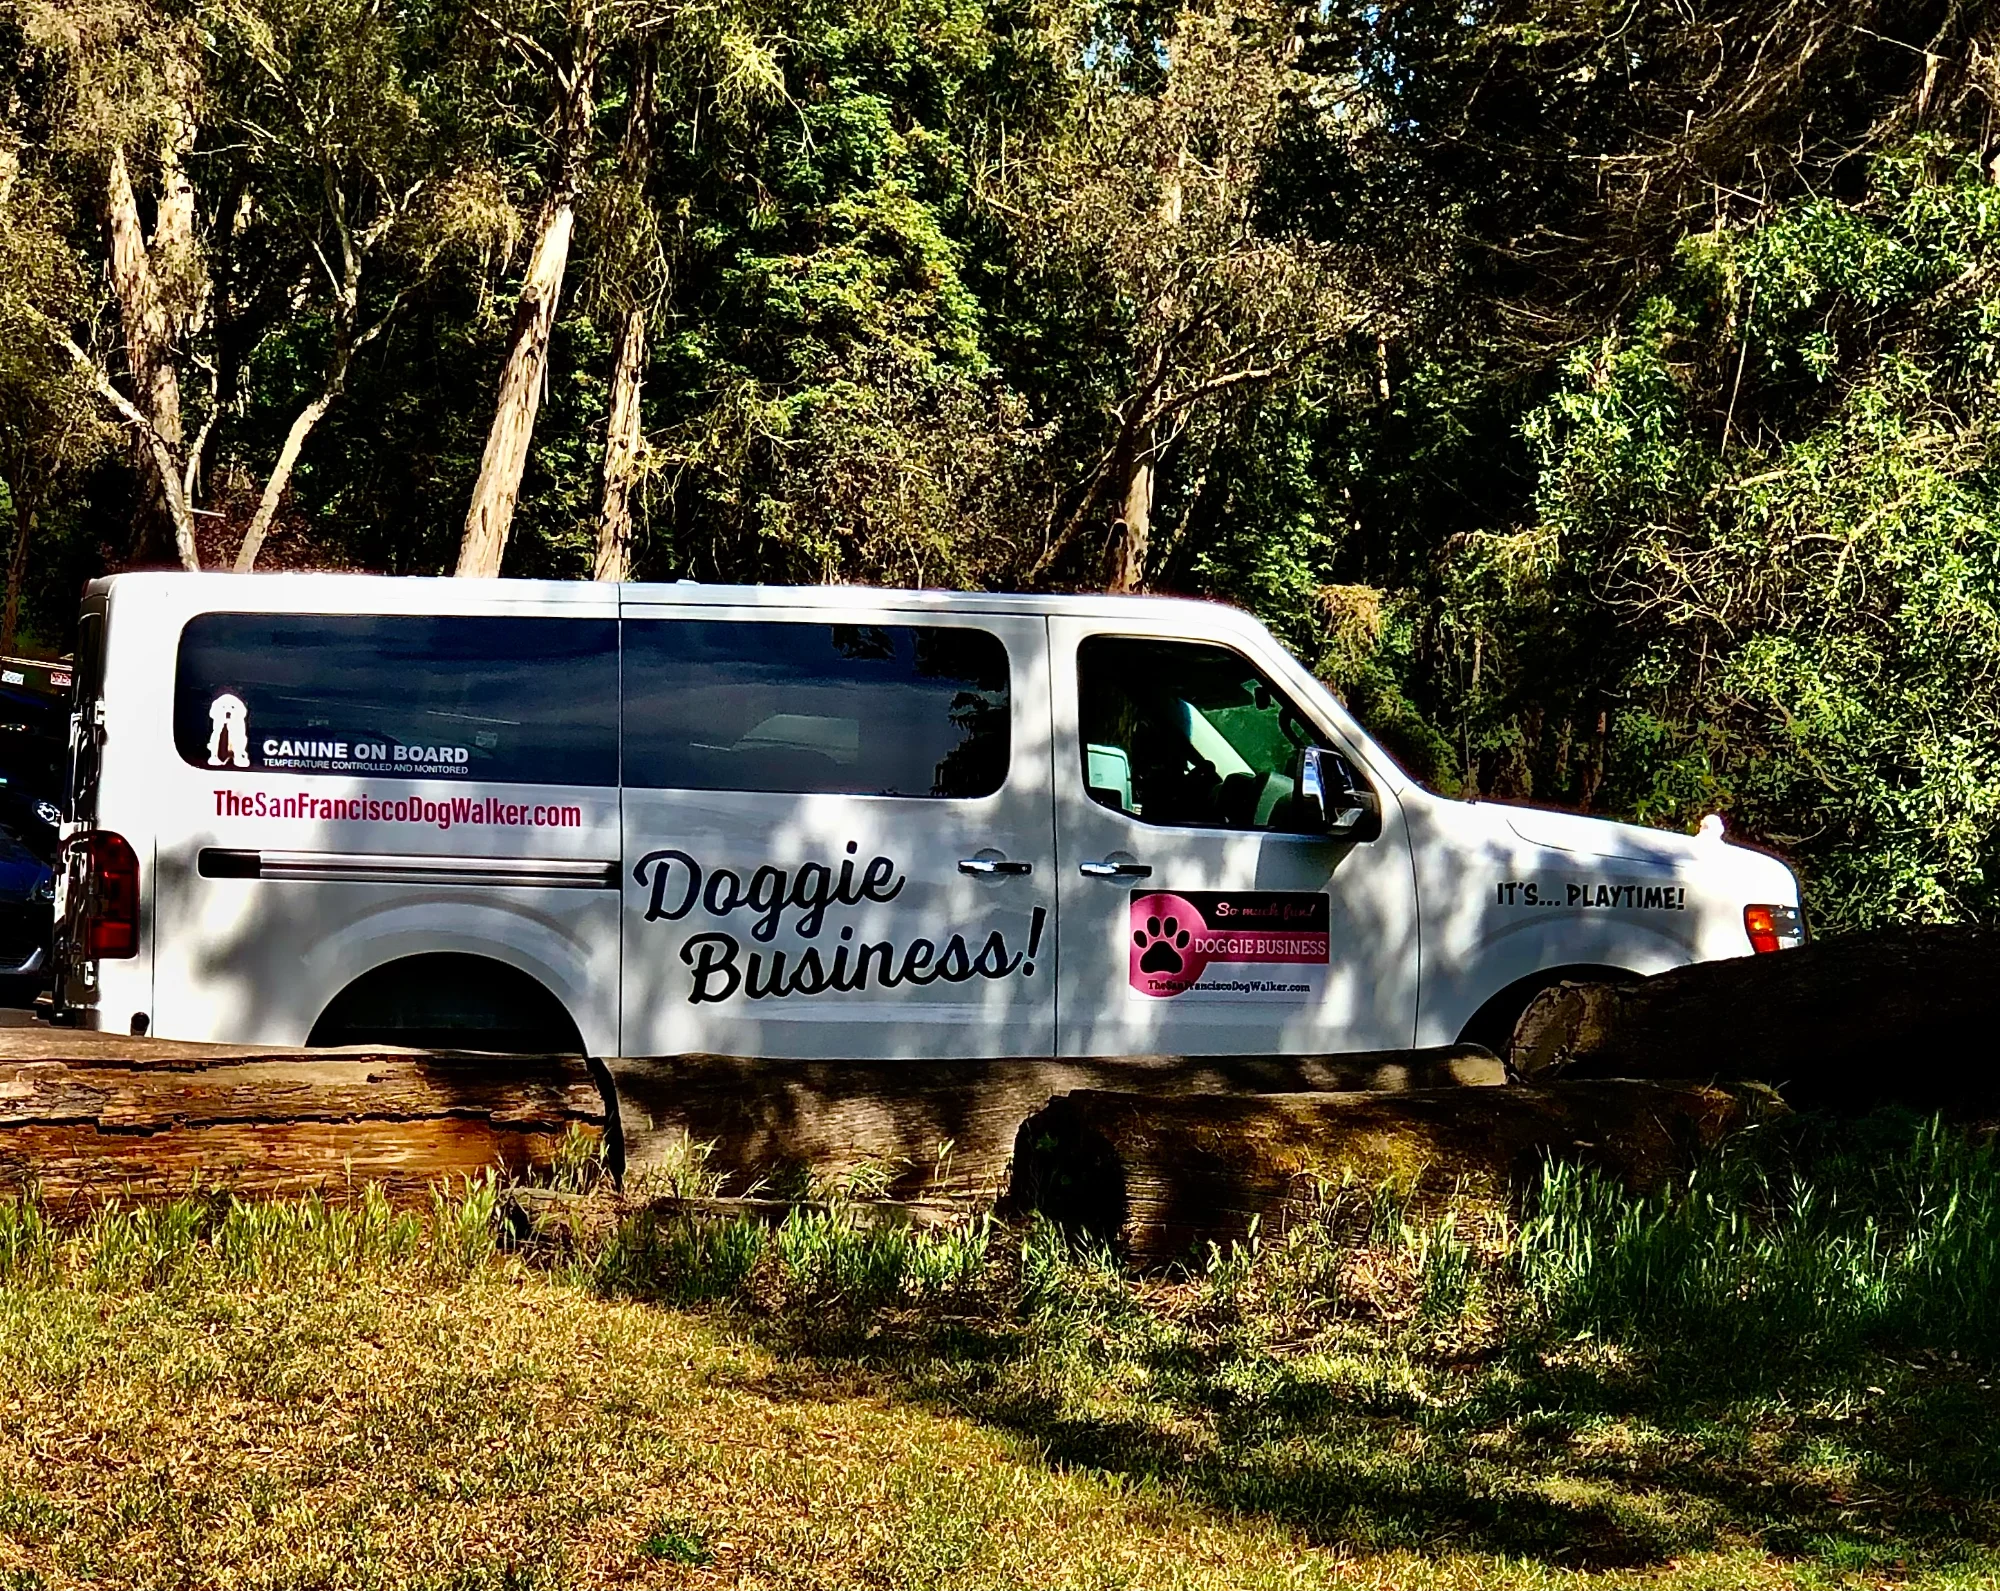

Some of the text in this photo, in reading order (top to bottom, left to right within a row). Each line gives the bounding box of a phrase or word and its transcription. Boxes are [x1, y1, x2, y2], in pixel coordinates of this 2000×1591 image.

[263, 739, 469, 763] CANINE ON BOARD
[263, 758, 469, 775] TEMPERATURE CONTROLLED AND MONITORED
[213, 790, 581, 830] TheSanFranciscoDogWalker.com
[633, 840, 906, 943] Doggie
[1497, 882, 1685, 911] IT'S... PLAYTIME!
[1215, 902, 1316, 921] So much fun!
[680, 906, 1047, 1005] Business!
[1194, 938, 1327, 956] DOGGIE BUSINESS
[1147, 980, 1311, 994] TheSanFranciscoDogWalker.com
